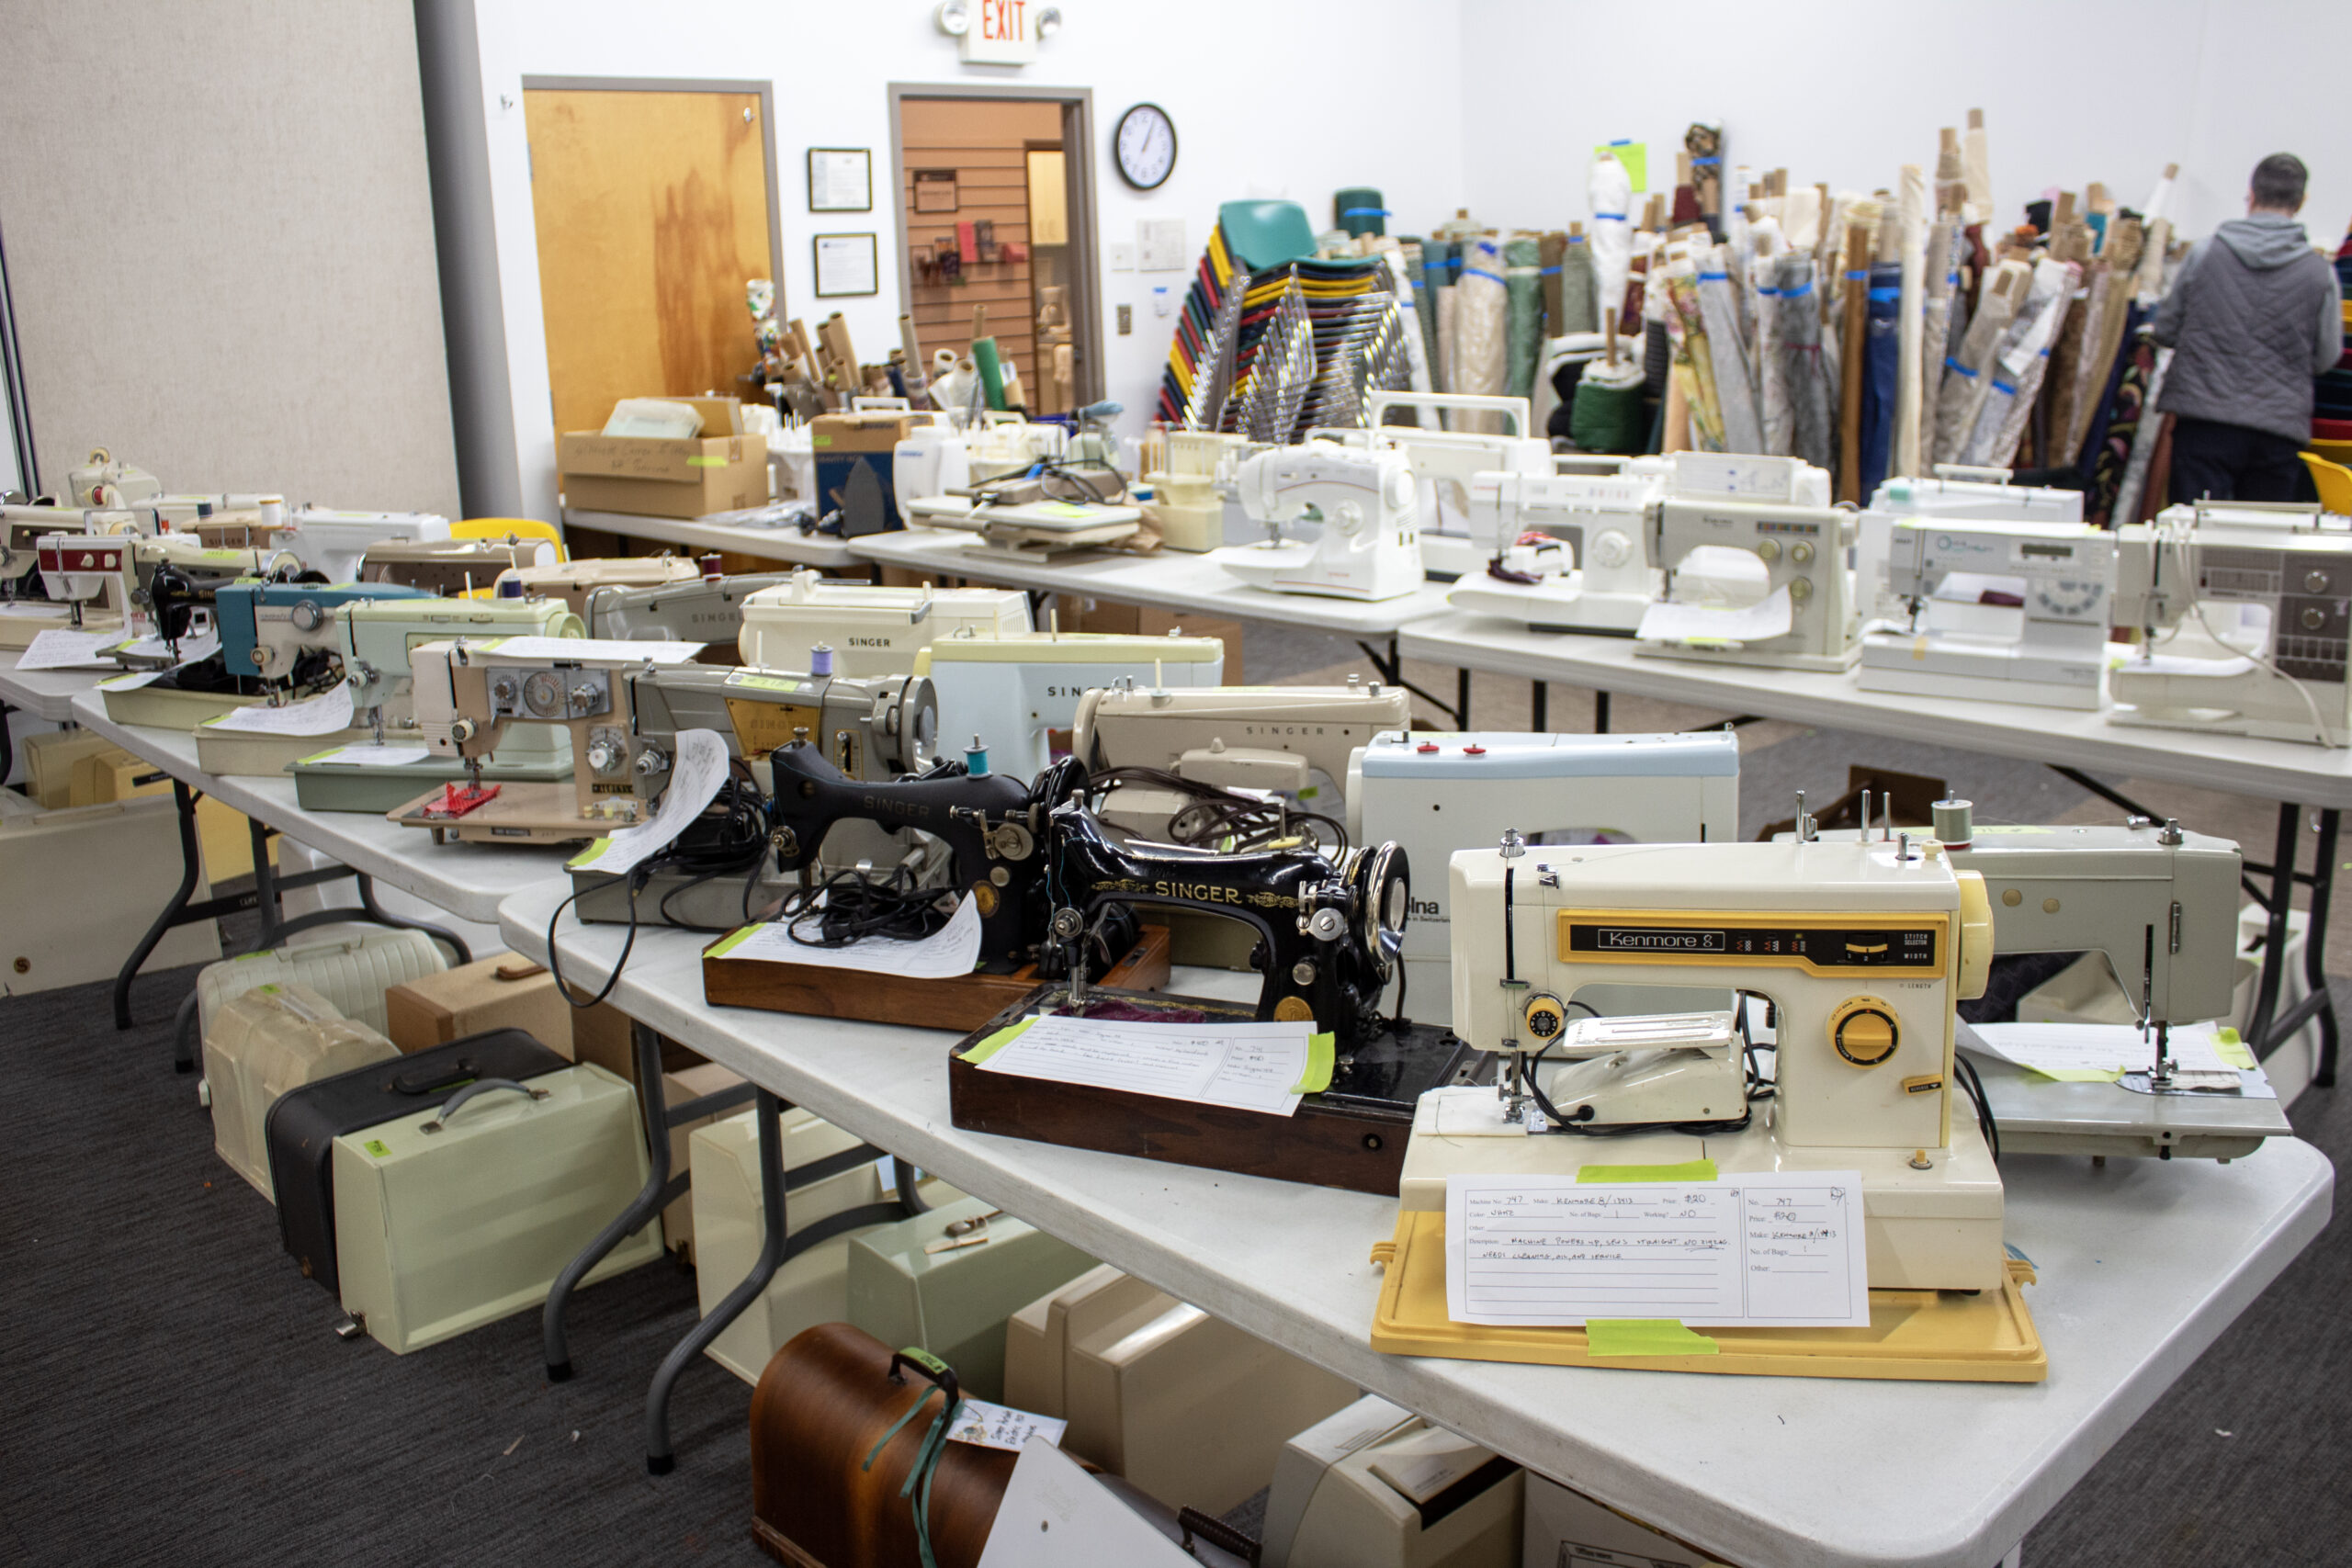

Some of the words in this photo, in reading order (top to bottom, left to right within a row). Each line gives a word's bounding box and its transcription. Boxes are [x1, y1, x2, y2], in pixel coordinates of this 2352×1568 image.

[983, 0, 1025, 40] EXIT
[848, 637, 891, 648] SINGER
[1246, 727, 1324, 735] SINGER
[864, 795, 930, 817] SINGER
[1155, 881, 1243, 905] SINGER
[1408, 897, 1439, 914] lna
[1610, 931, 1697, 948] Kenmore
[1702, 934, 1713, 948] 8
[1507, 1195, 1523, 1204] 747
[1679, 1209, 1697, 1218] NO
